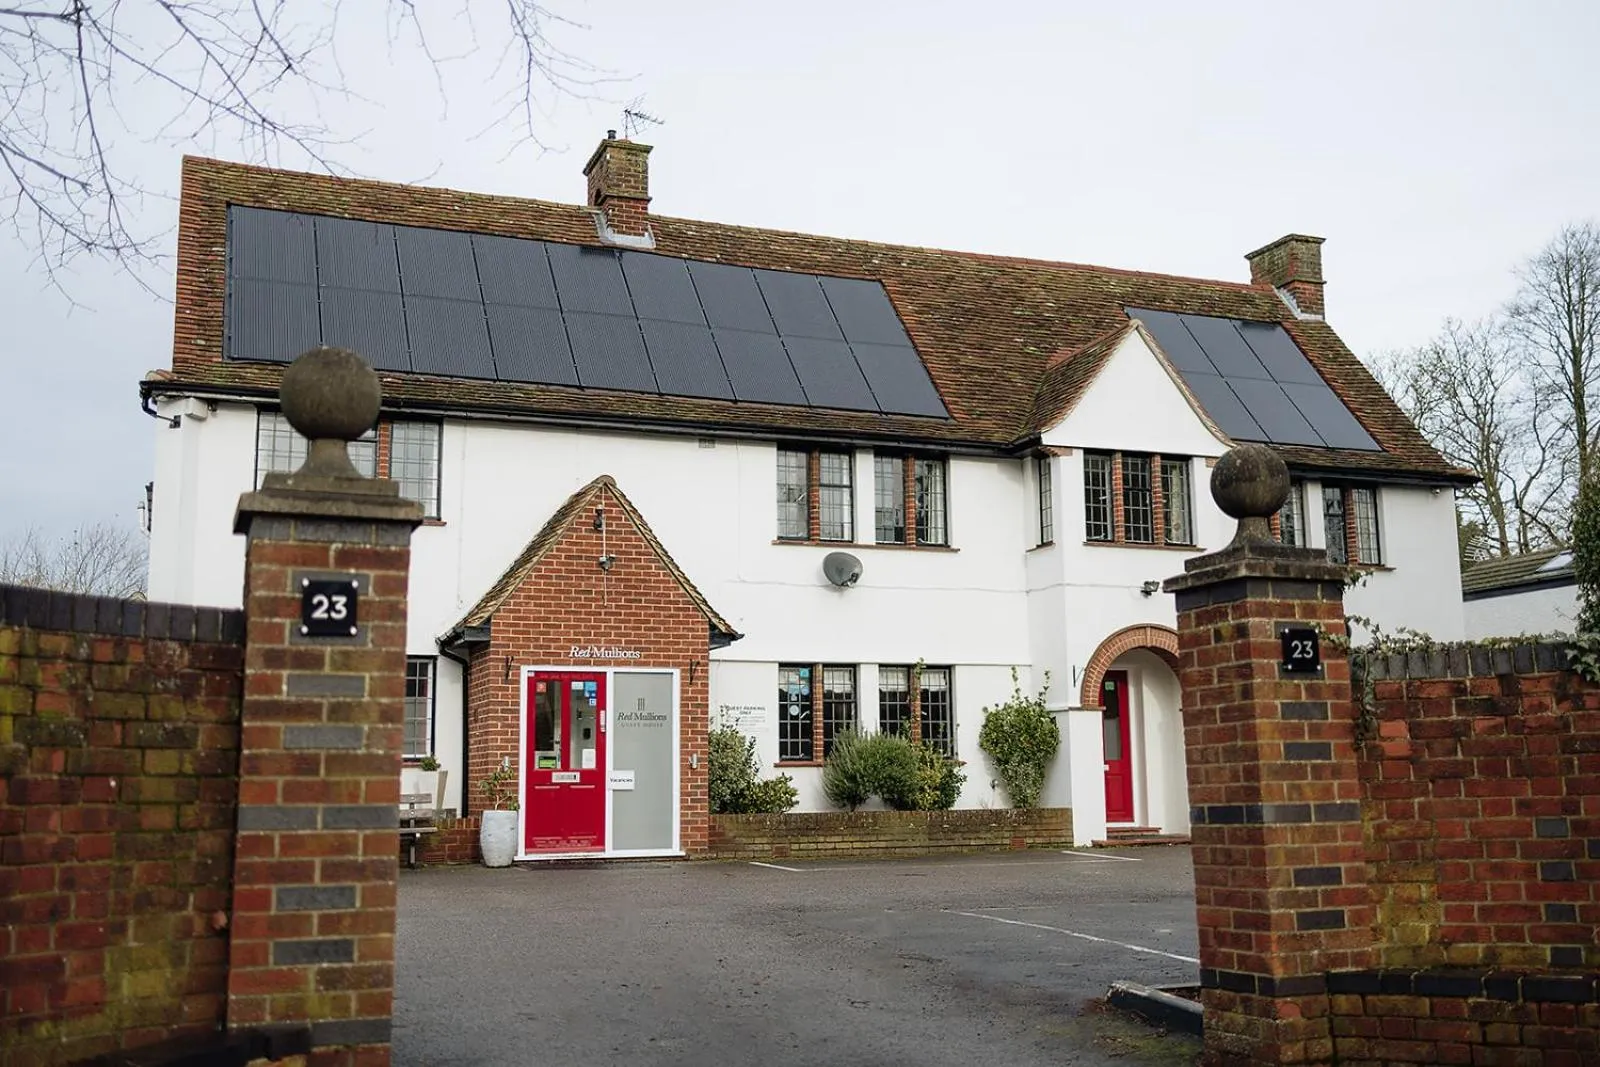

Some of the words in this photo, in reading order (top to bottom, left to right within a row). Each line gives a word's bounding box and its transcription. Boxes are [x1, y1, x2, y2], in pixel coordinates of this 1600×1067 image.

[311, 593, 347, 620] 23
[569, 646, 591, 658] Red
[592, 646, 641, 659] Mullions
[1291, 640, 1314, 659] 23
[617, 712, 633, 720] Red
[634, 712, 667, 721] Mullions
